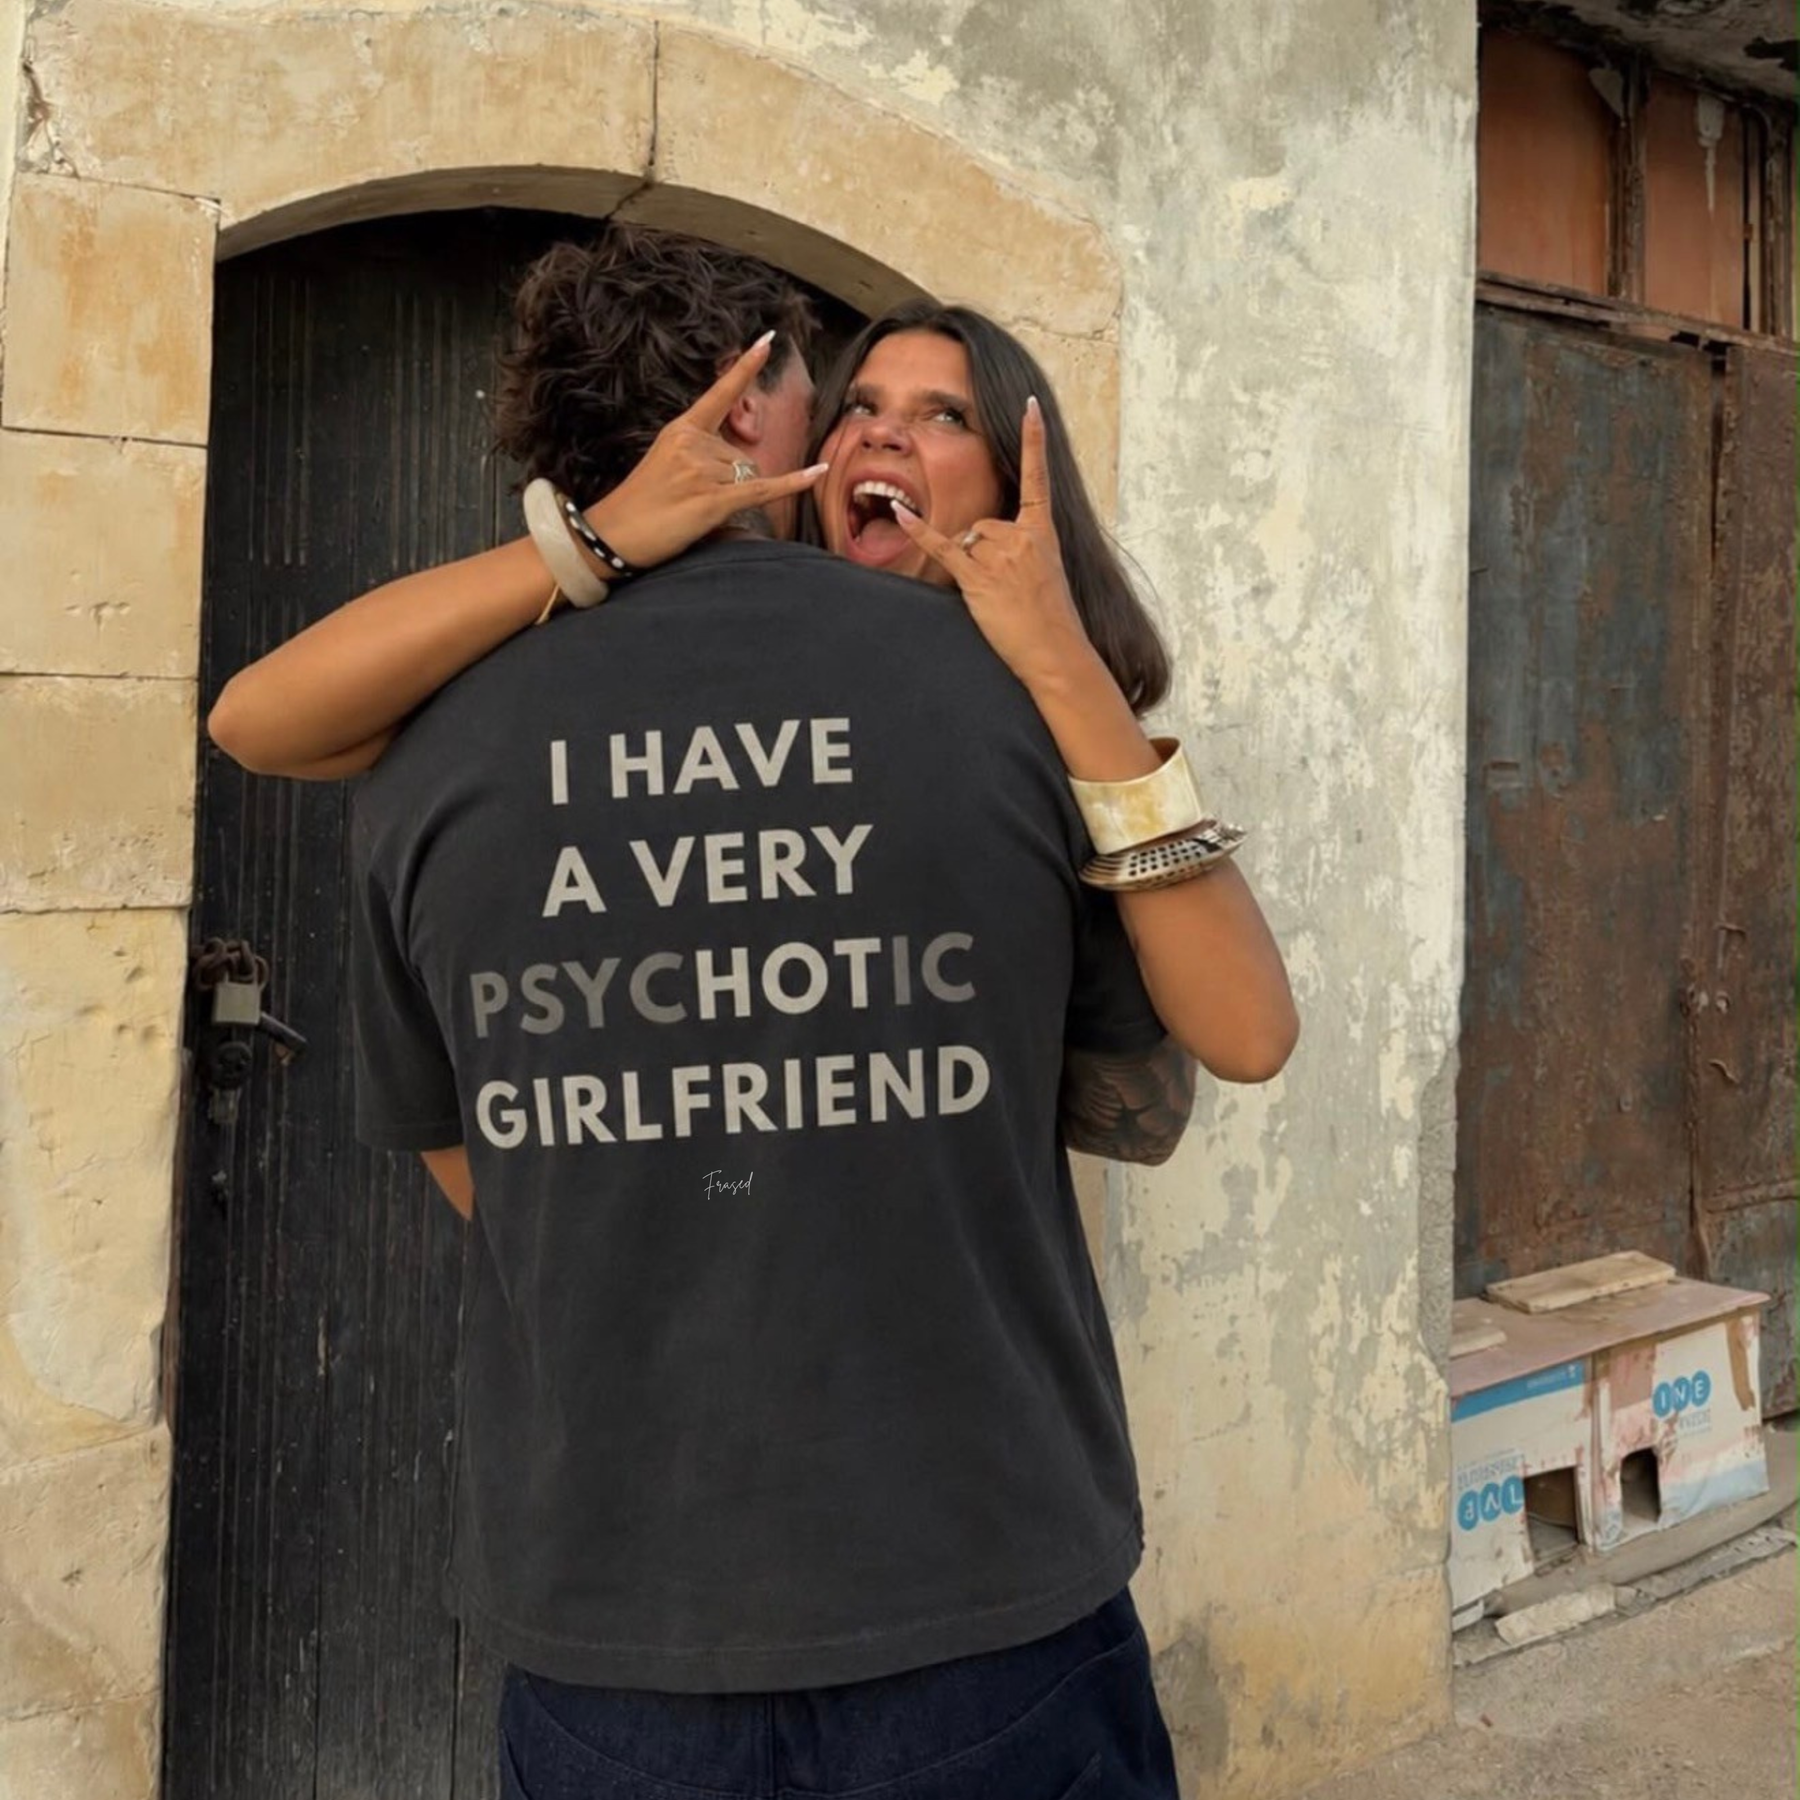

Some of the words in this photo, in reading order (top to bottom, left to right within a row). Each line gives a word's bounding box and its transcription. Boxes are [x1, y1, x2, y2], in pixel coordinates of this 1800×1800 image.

[551, 740, 568, 805] I
[610, 718, 852, 798] HAVE
[543, 846, 606, 917] A
[629, 824, 873, 907] VERY
[470, 932, 976, 1038] PSYCHOTIC
[476, 1045, 991, 1148] GIRLFRIEND
